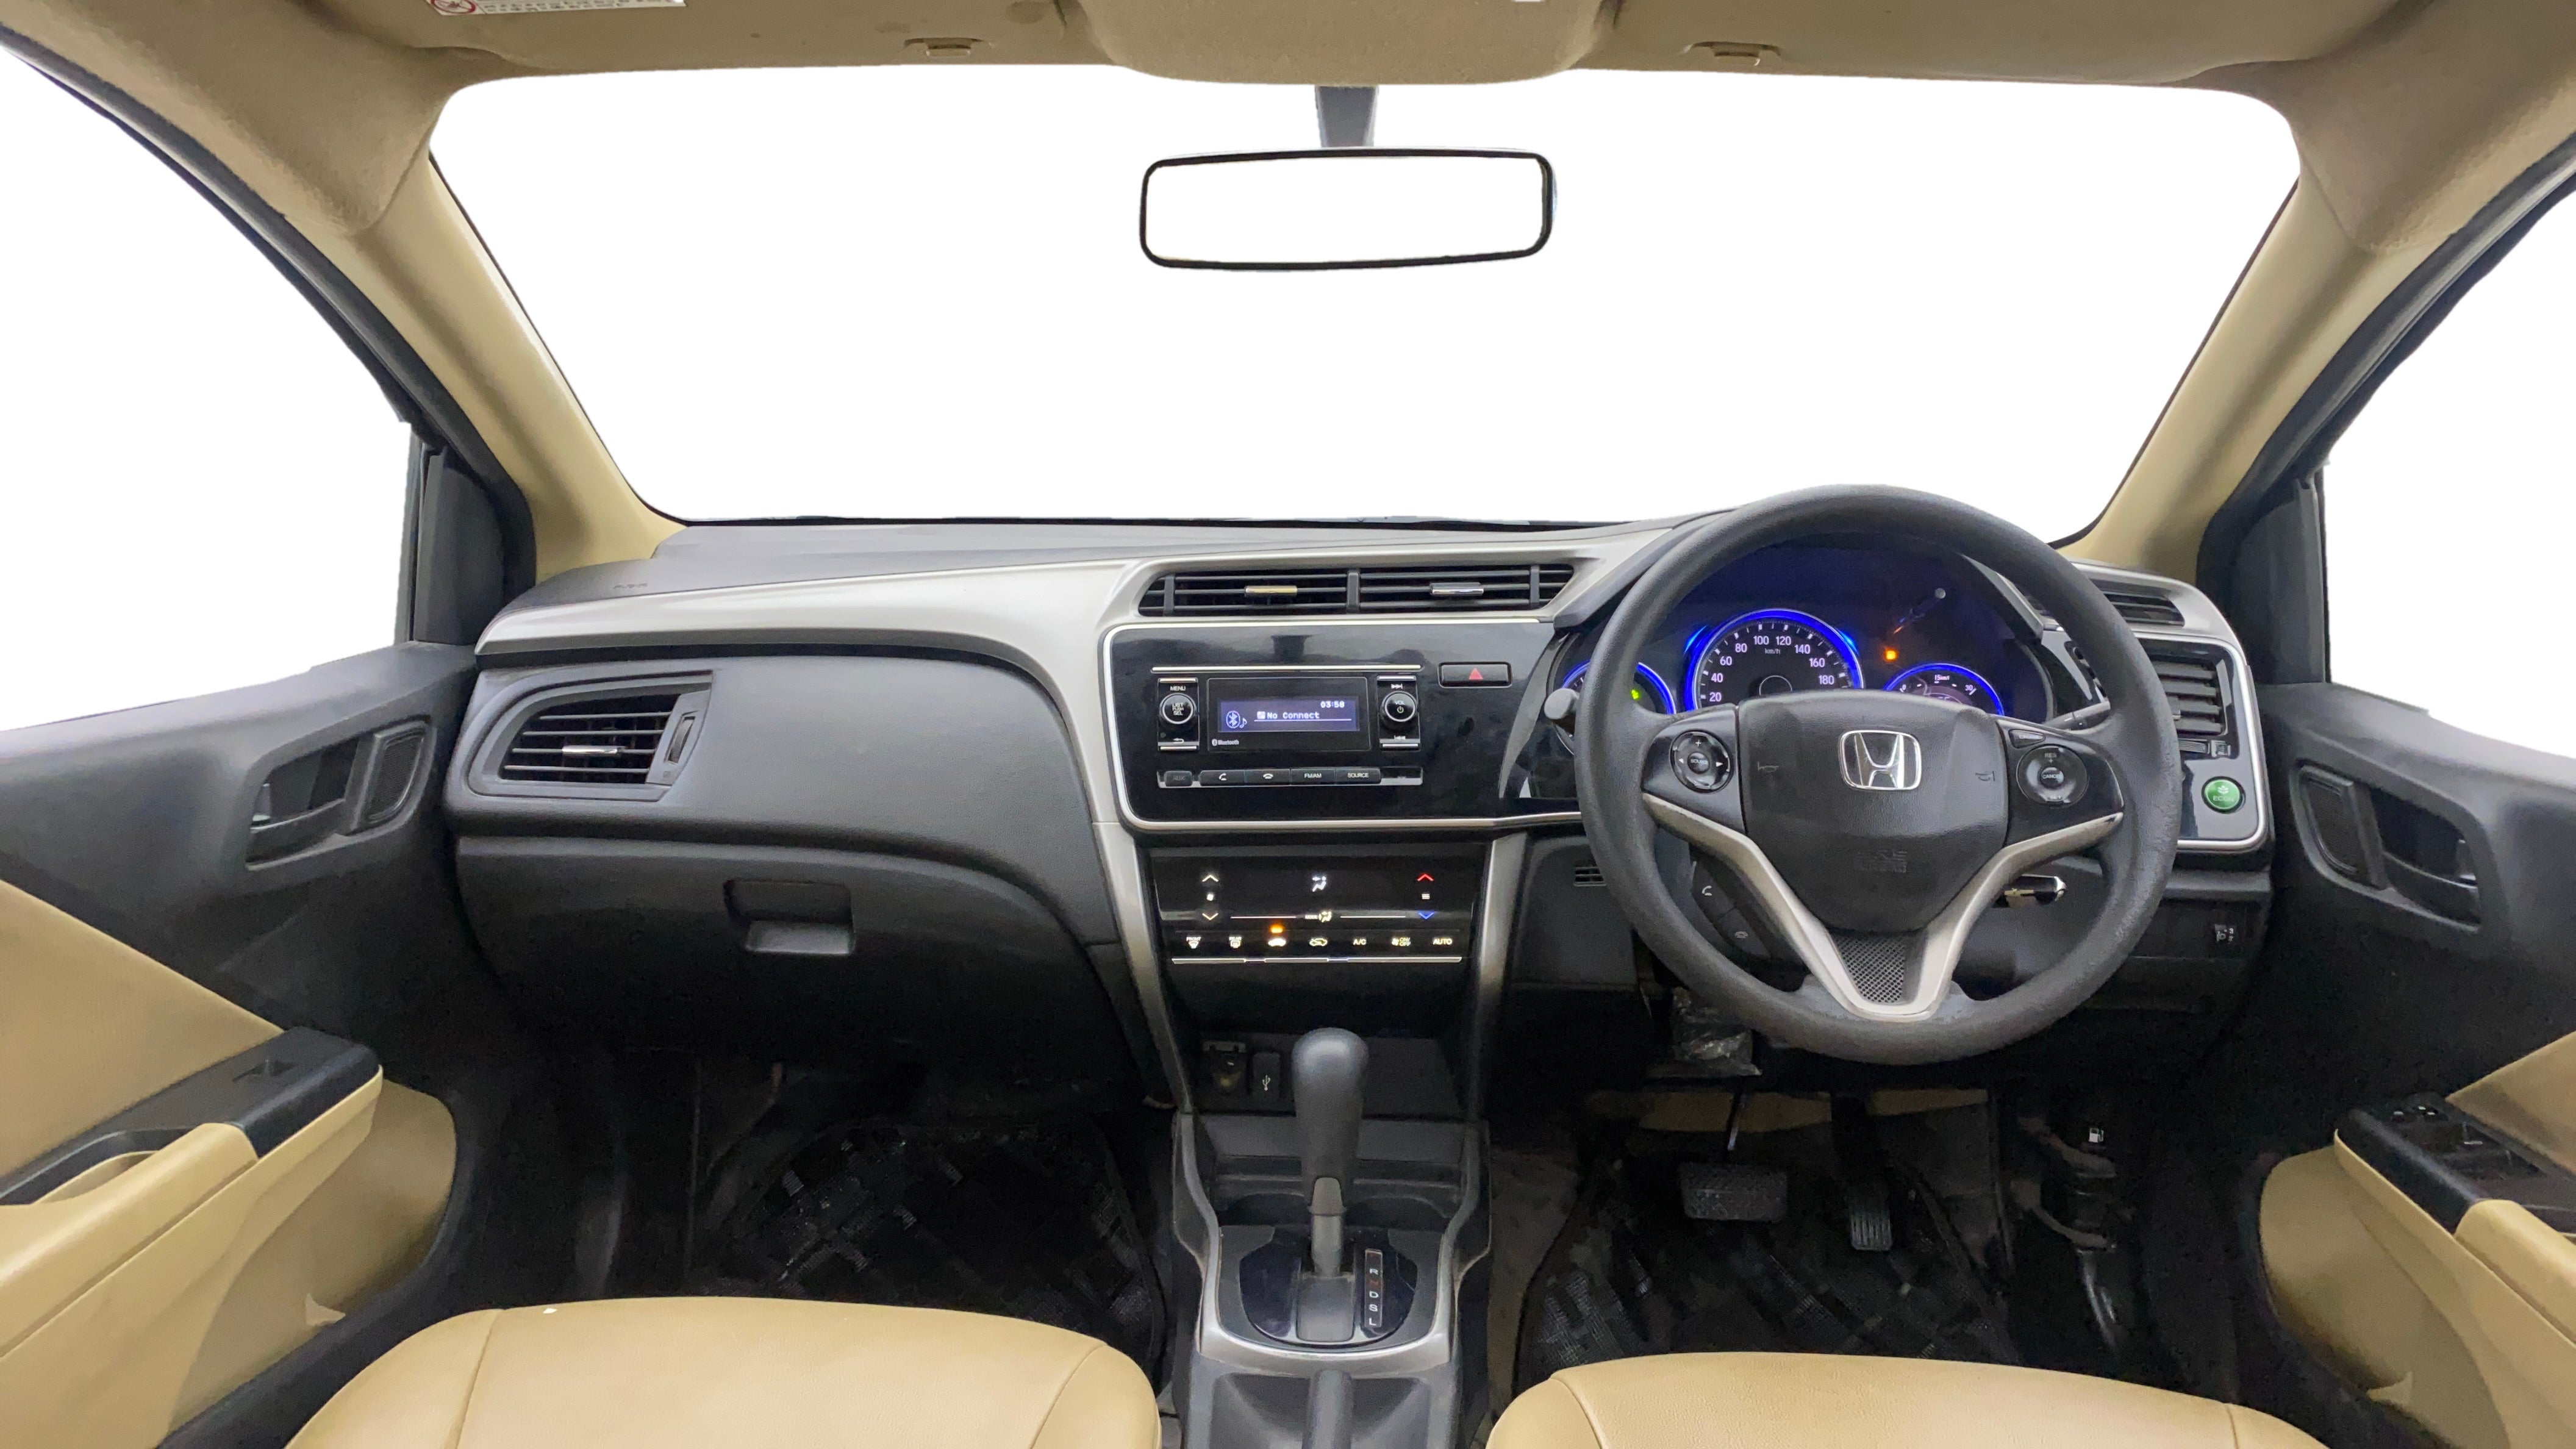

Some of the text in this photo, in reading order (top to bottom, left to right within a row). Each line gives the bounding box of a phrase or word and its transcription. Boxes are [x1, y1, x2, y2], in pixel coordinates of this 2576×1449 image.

[1753, 635, 1769, 645] 100
[1776, 635, 1792, 646] 120
[1735, 643, 1747, 653] 80
[1794, 644, 1811, 654] 140
[1720, 656, 1733, 666] 60
[1809, 657, 1825, 668] 160
[1711, 673, 1723, 683] 40
[1819, 674, 1835, 685] 180
[1709, 692, 1722, 702] 20
[1283, 711, 1320, 720] Connect
[1368, 1317, 1377, 1326] L
